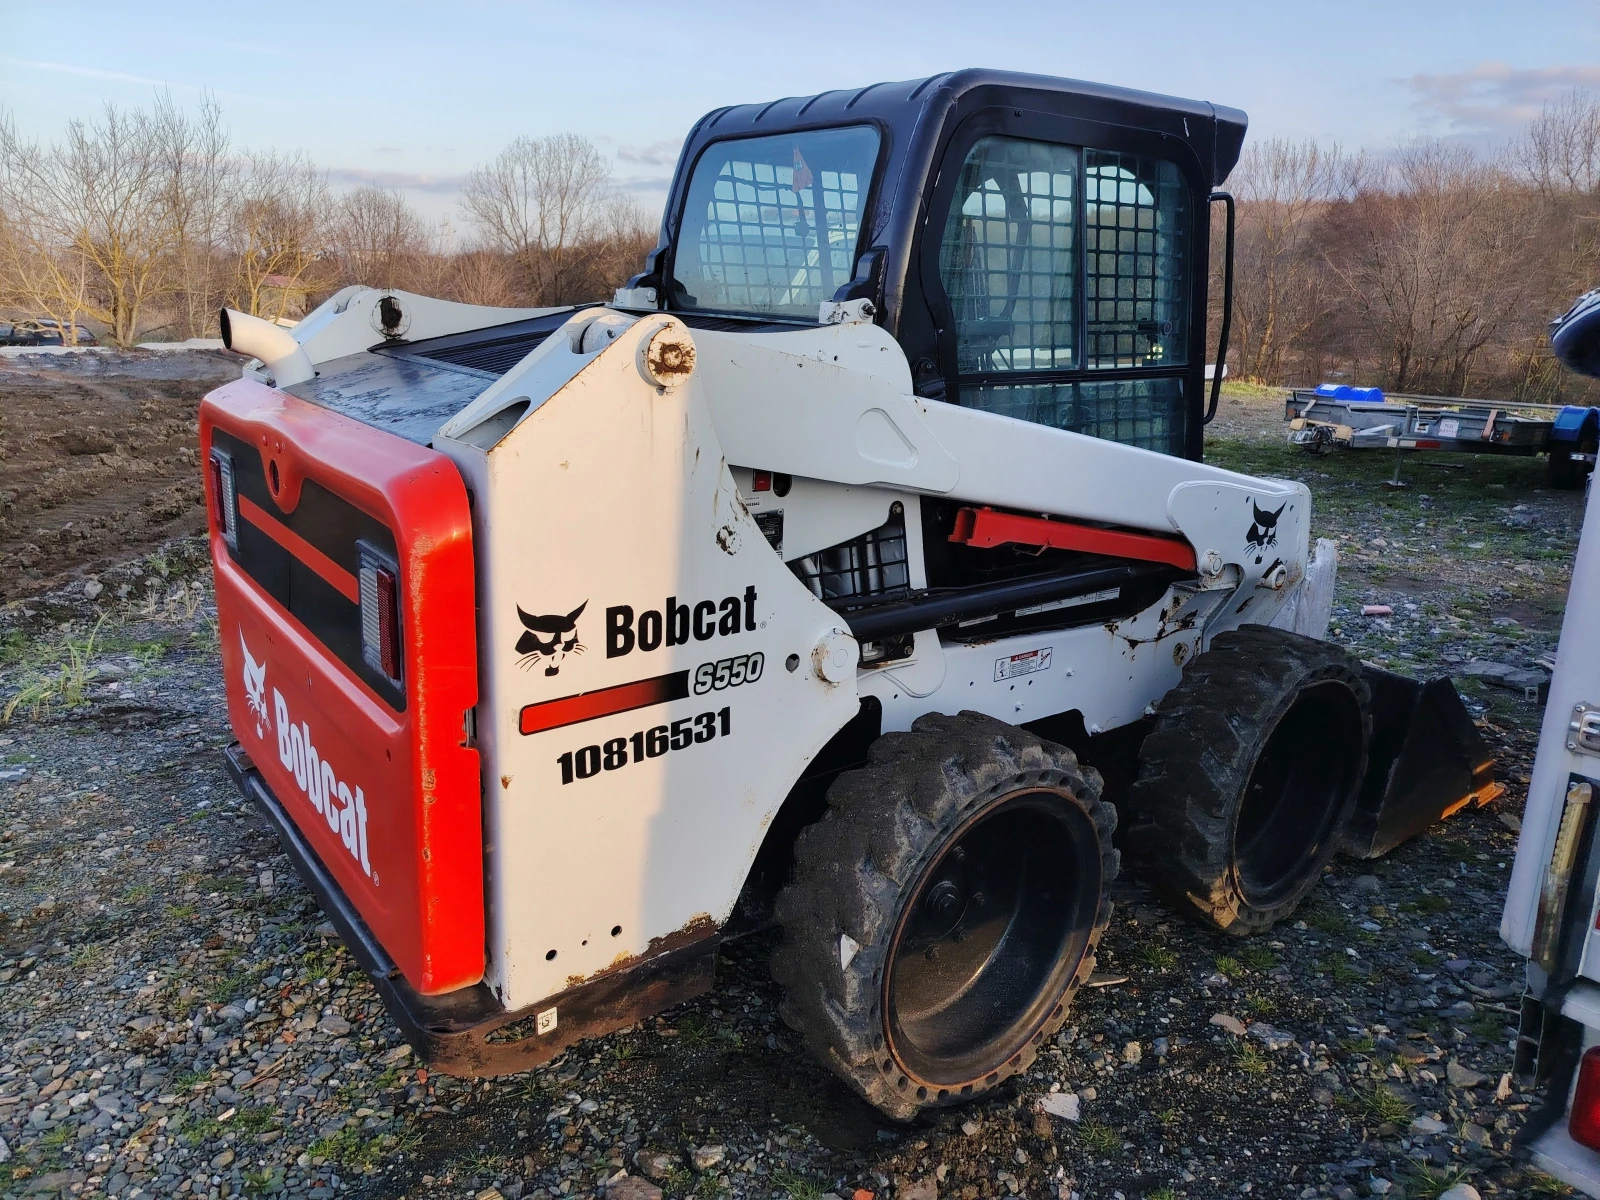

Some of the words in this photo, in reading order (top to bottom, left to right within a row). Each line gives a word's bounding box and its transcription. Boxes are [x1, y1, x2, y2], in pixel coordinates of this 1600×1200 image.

[606, 585, 758, 659] Bobcat
[693, 652, 765, 696] S550
[273, 686, 371, 877] Bobcat
[556, 706, 732, 786] 10816531
